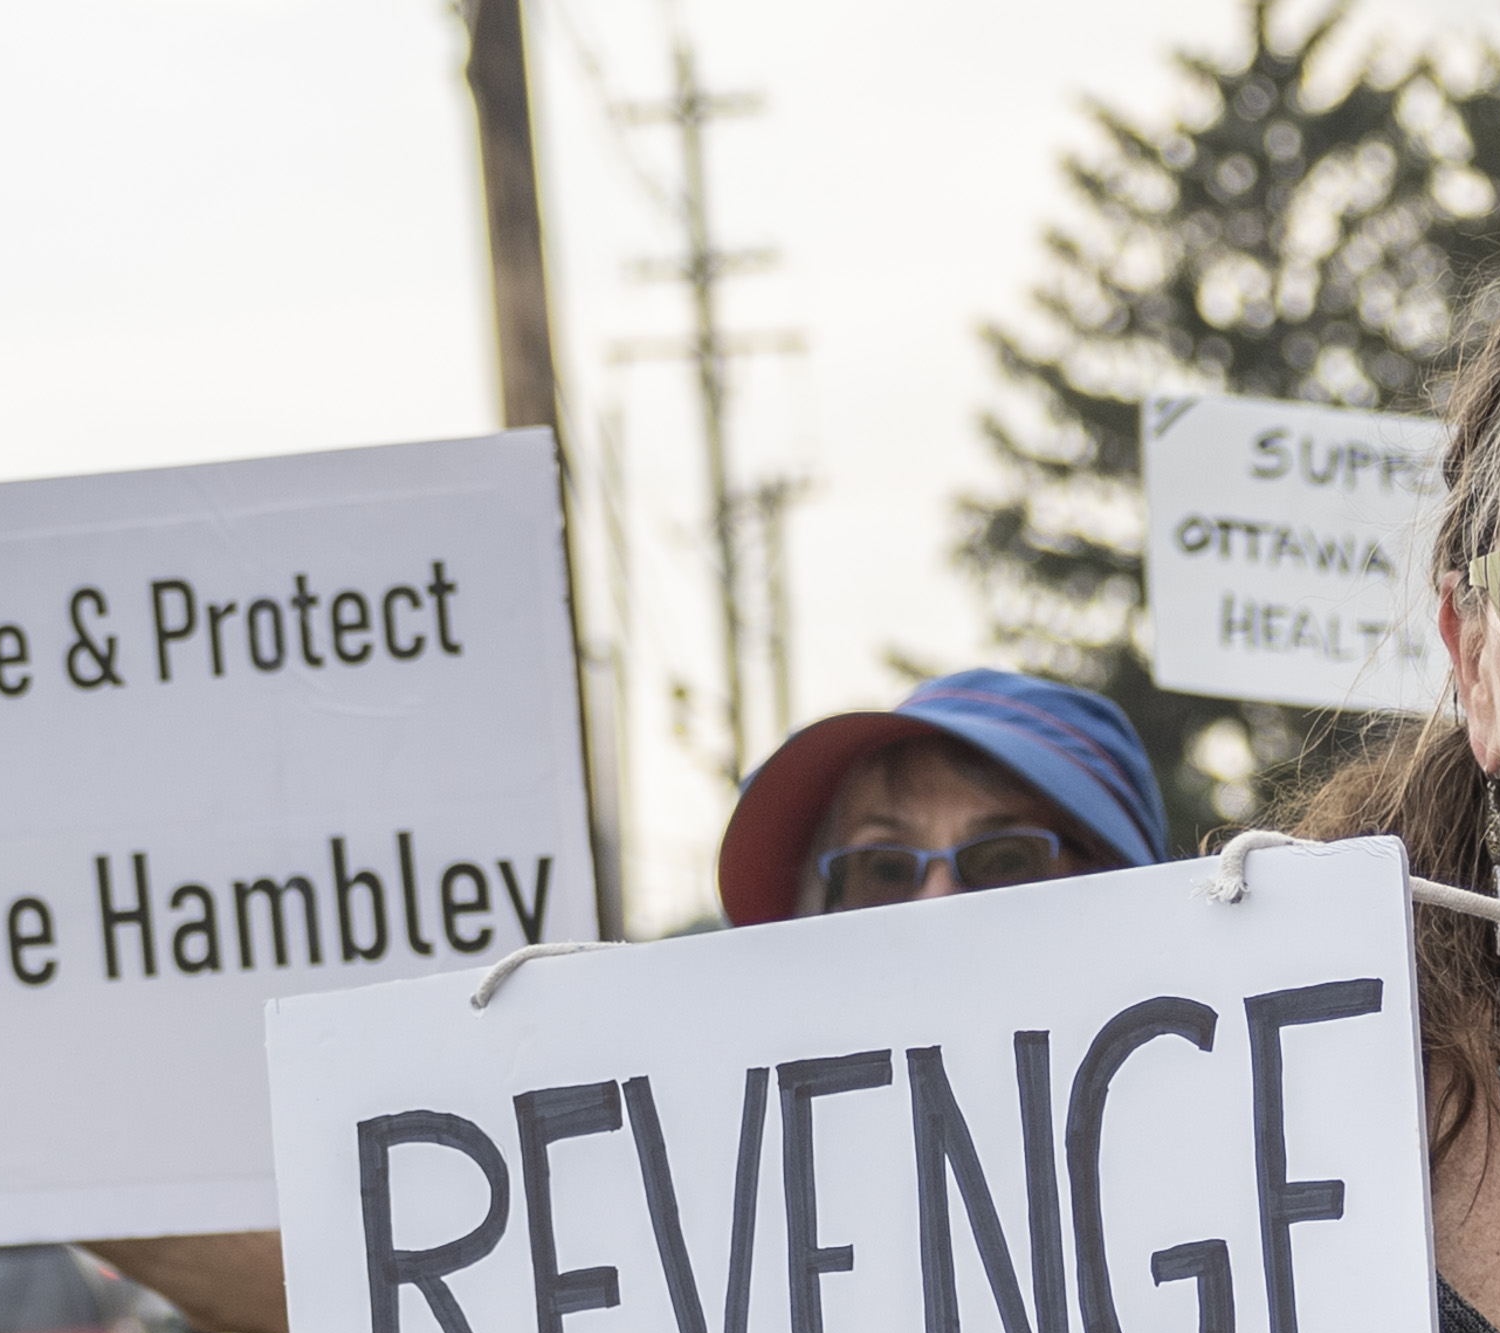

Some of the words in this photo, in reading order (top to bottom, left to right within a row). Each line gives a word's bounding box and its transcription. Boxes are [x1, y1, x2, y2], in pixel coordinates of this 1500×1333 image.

[1174, 514, 1397, 579] OTTAWA
[65, 585, 124, 691] &
[150, 560, 462, 684] Protect
[94, 831, 554, 980] Hambley
